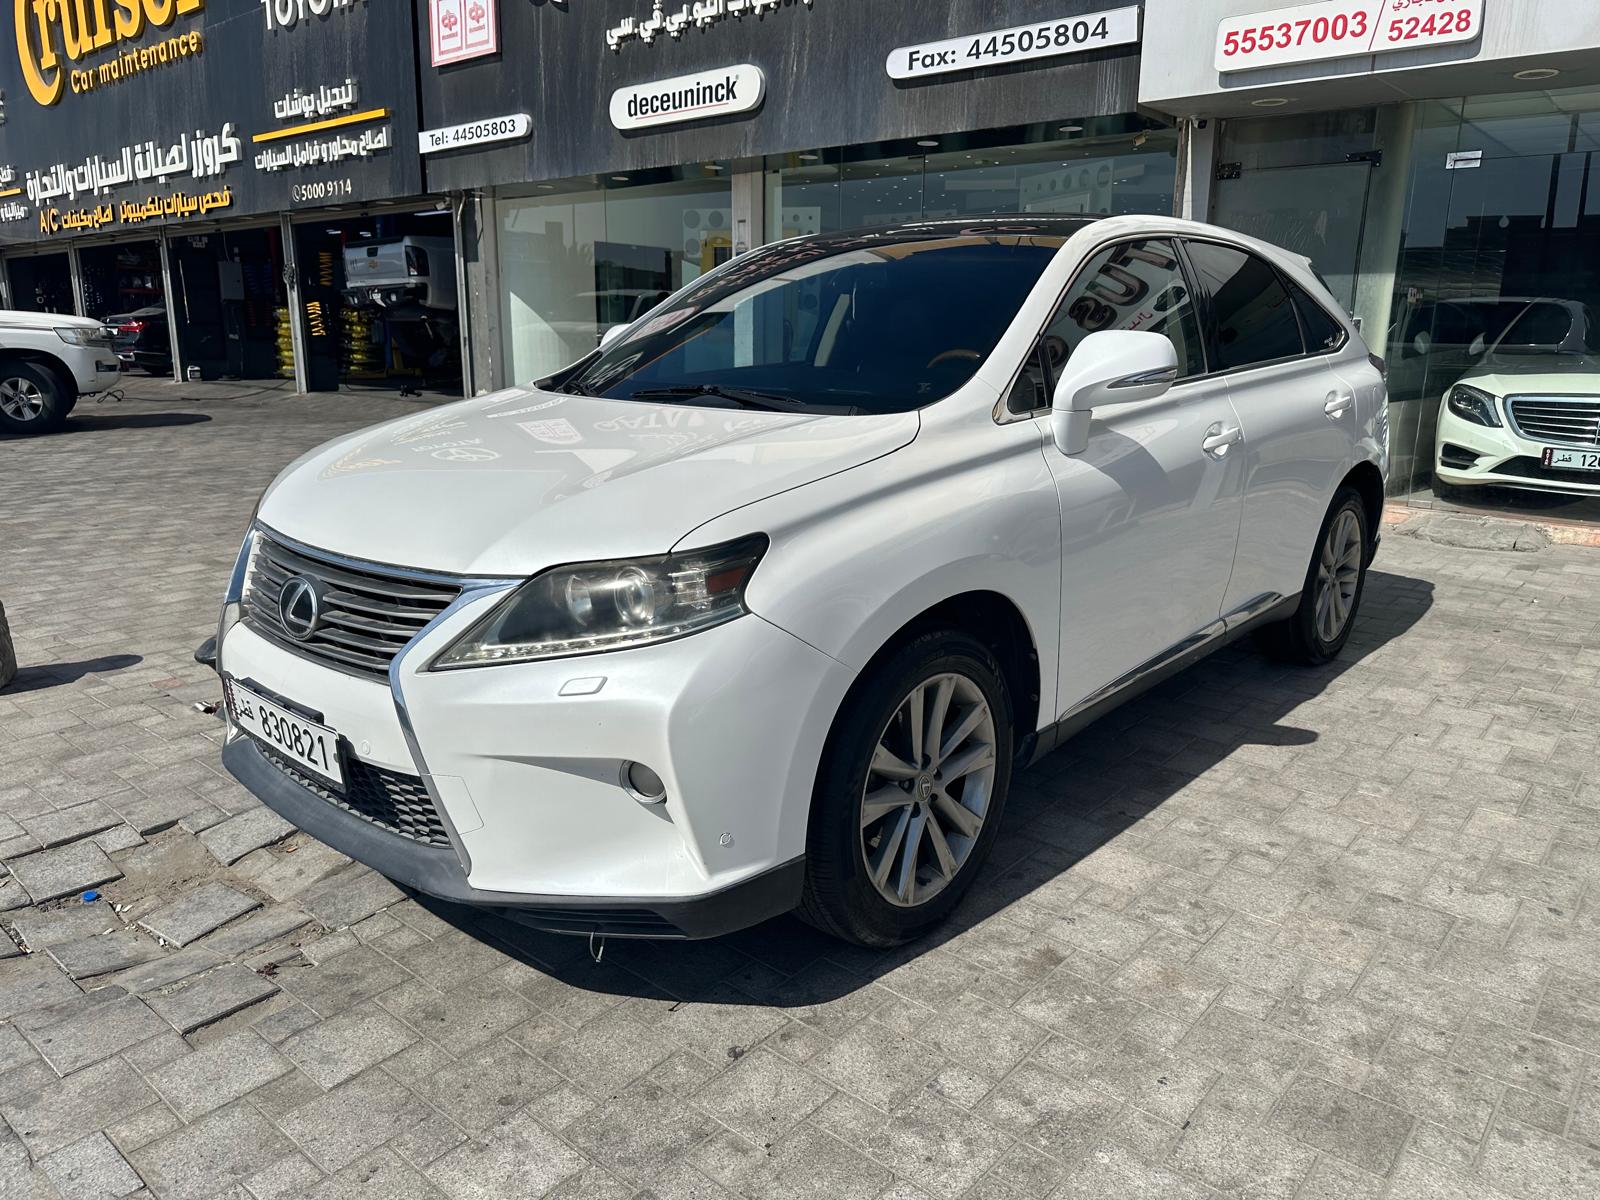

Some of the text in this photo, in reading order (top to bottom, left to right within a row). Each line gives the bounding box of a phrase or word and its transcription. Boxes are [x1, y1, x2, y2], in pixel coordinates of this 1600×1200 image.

[260, 0, 348, 30] TOY
[1388, 9, 1471, 42] 52428
[907, 17, 1109, 71] Fax: 44505804
[1223, 10, 1368, 56] 55537003
[70, 30, 201, 94] Car maintenance
[316, 78, 353, 115] تبديل
[627, 75, 738, 117] deceuninck
[429, 119, 516, 147] Tel: 44505803
[134, 133, 188, 184] لصيانة
[190, 122, 240, 179] كروزر
[254, 144, 292, 171] السيارات
[73, 146, 133, 197] السيارات
[164, 191, 198, 217] سيارات
[199, 184, 231, 215] فحص
[301, 178, 352, 201] 5000 9114
[40, 207, 59, 235] A/C
[1553, 453, 1573, 464] قطر
[1581, 454, 1600, 468] 12
[238, 697, 255, 720] قطر
[259, 705, 330, 771] 830821
